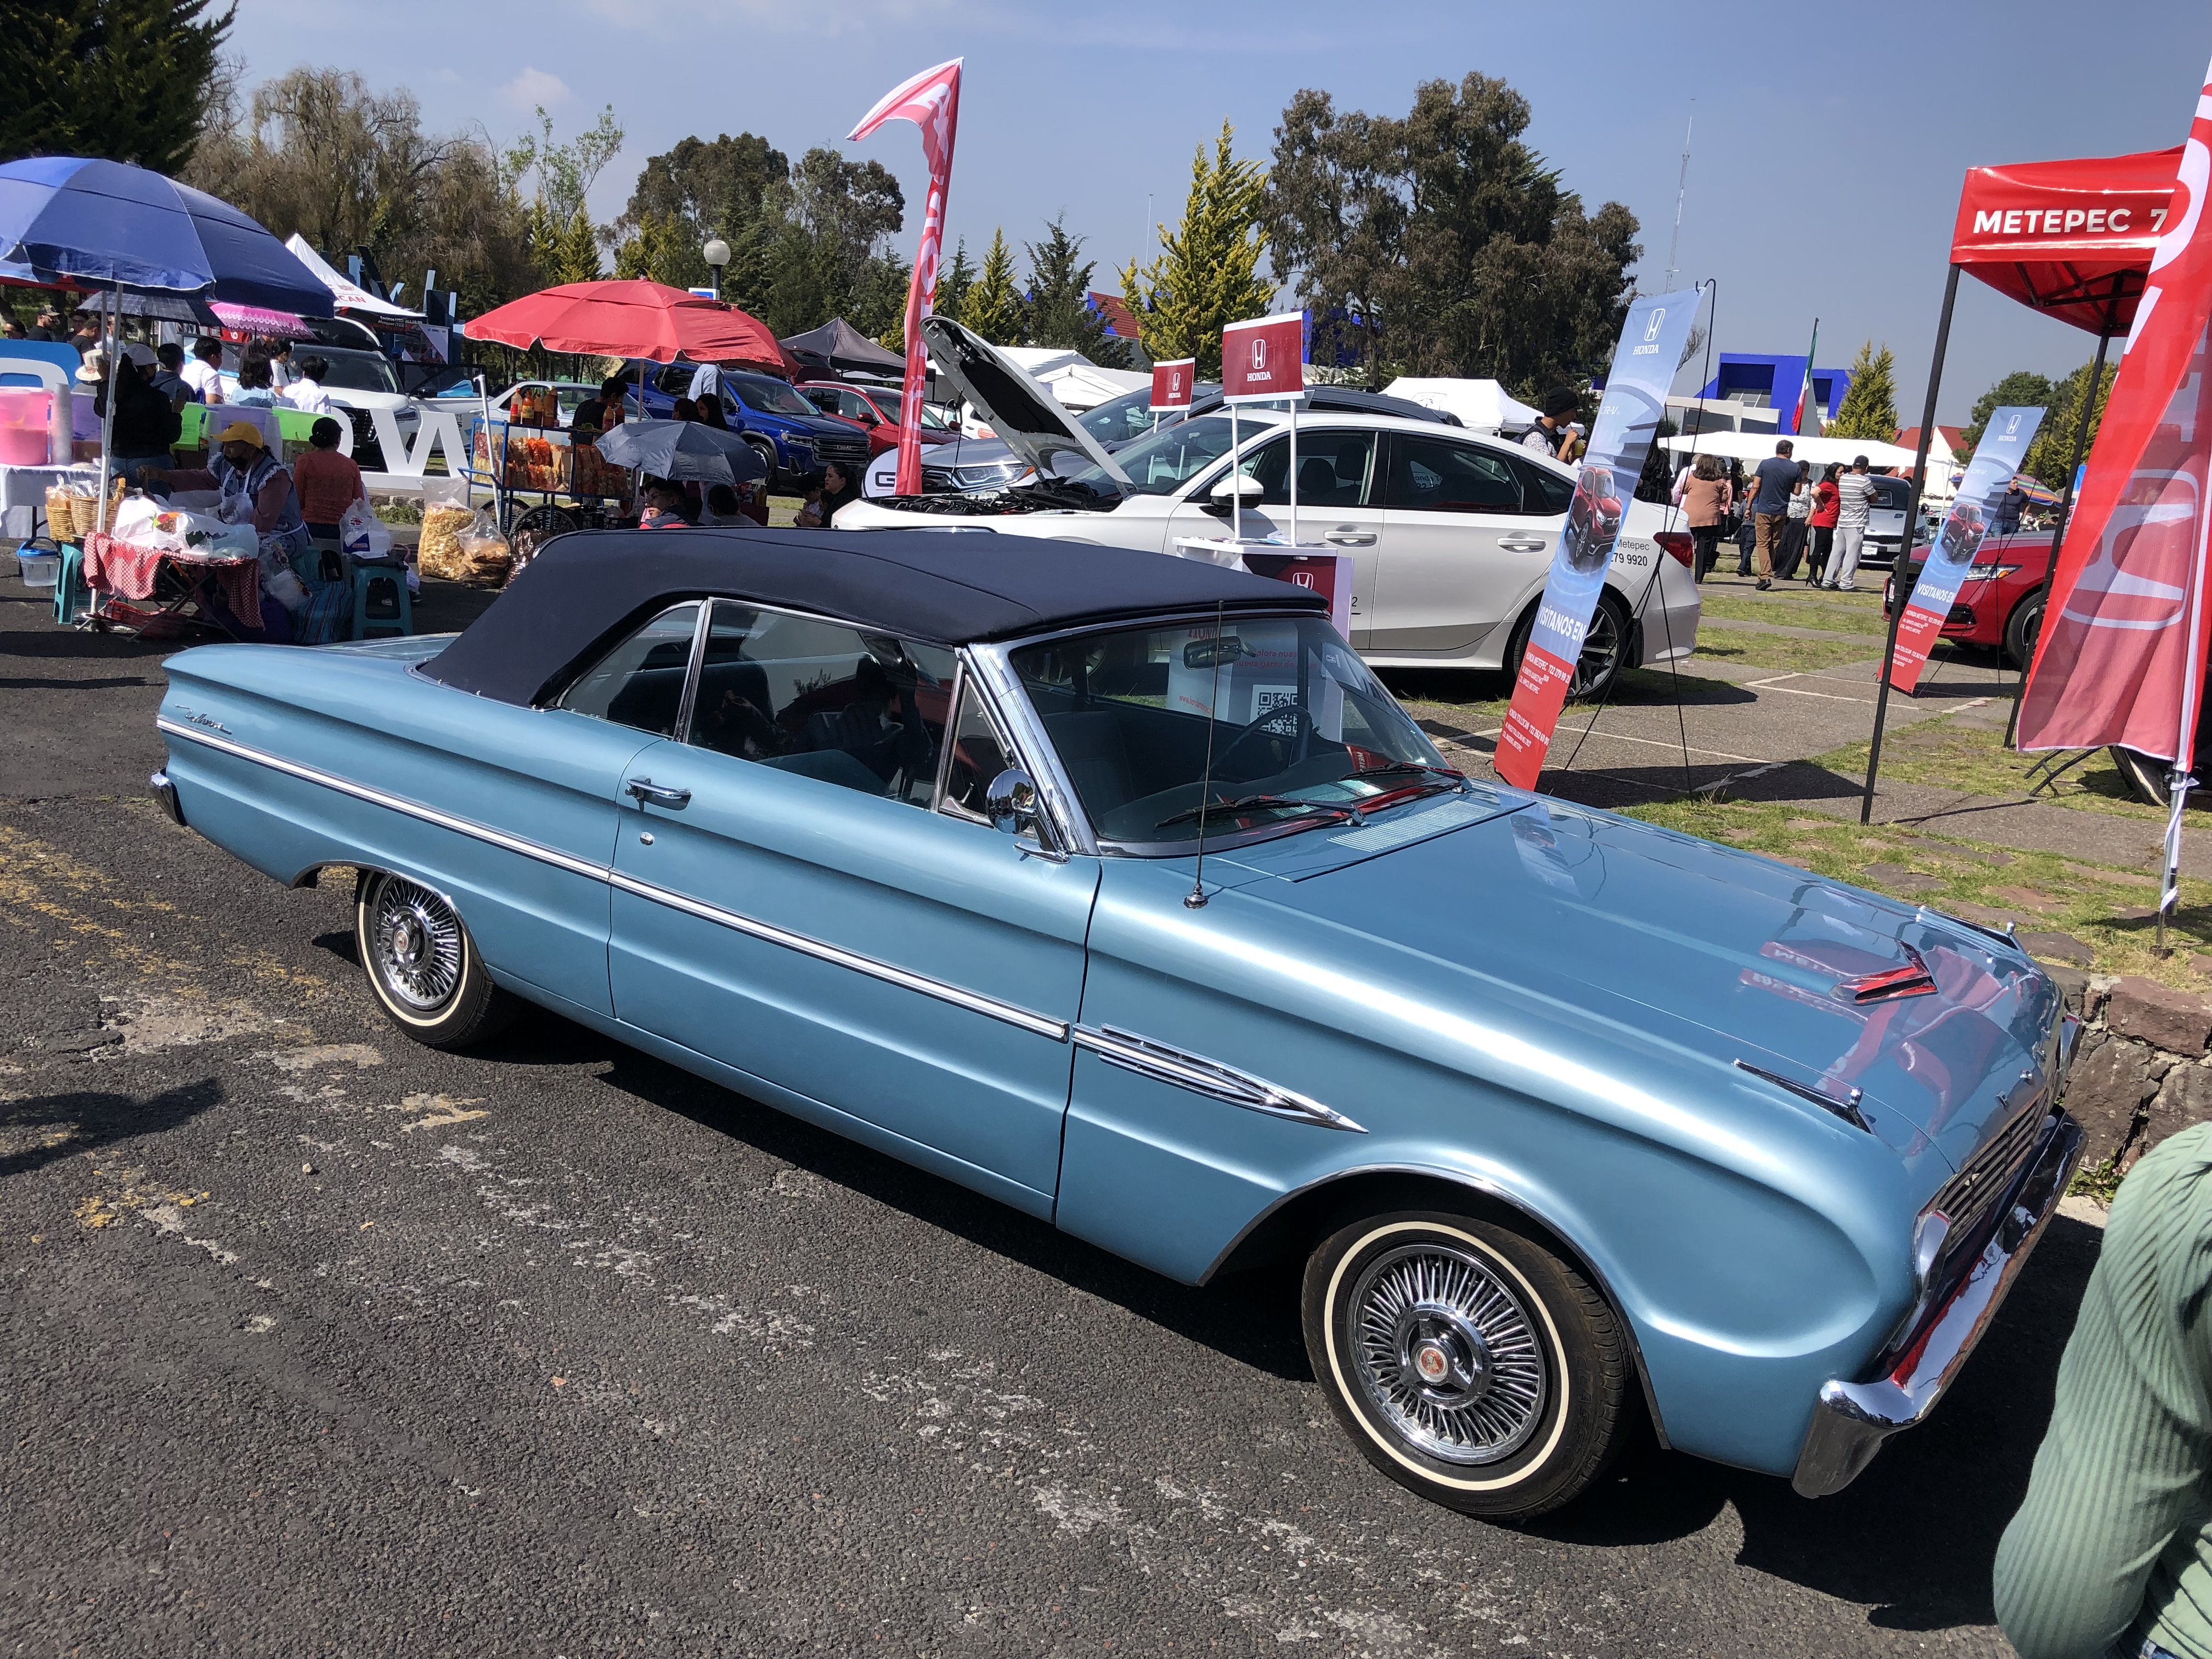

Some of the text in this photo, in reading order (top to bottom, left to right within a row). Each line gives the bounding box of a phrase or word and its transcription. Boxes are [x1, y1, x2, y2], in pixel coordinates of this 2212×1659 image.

[1973, 208, 2132, 234] METEPEC
[1633, 344, 1659, 355] HONDA
[1246, 371, 1272, 382] HONDA
[1611, 552, 1647, 567] 79 9920
[1917, 583, 1949, 602] VISÍTANOS
[1537, 605, 1587, 644] VISÍTANOS EN
